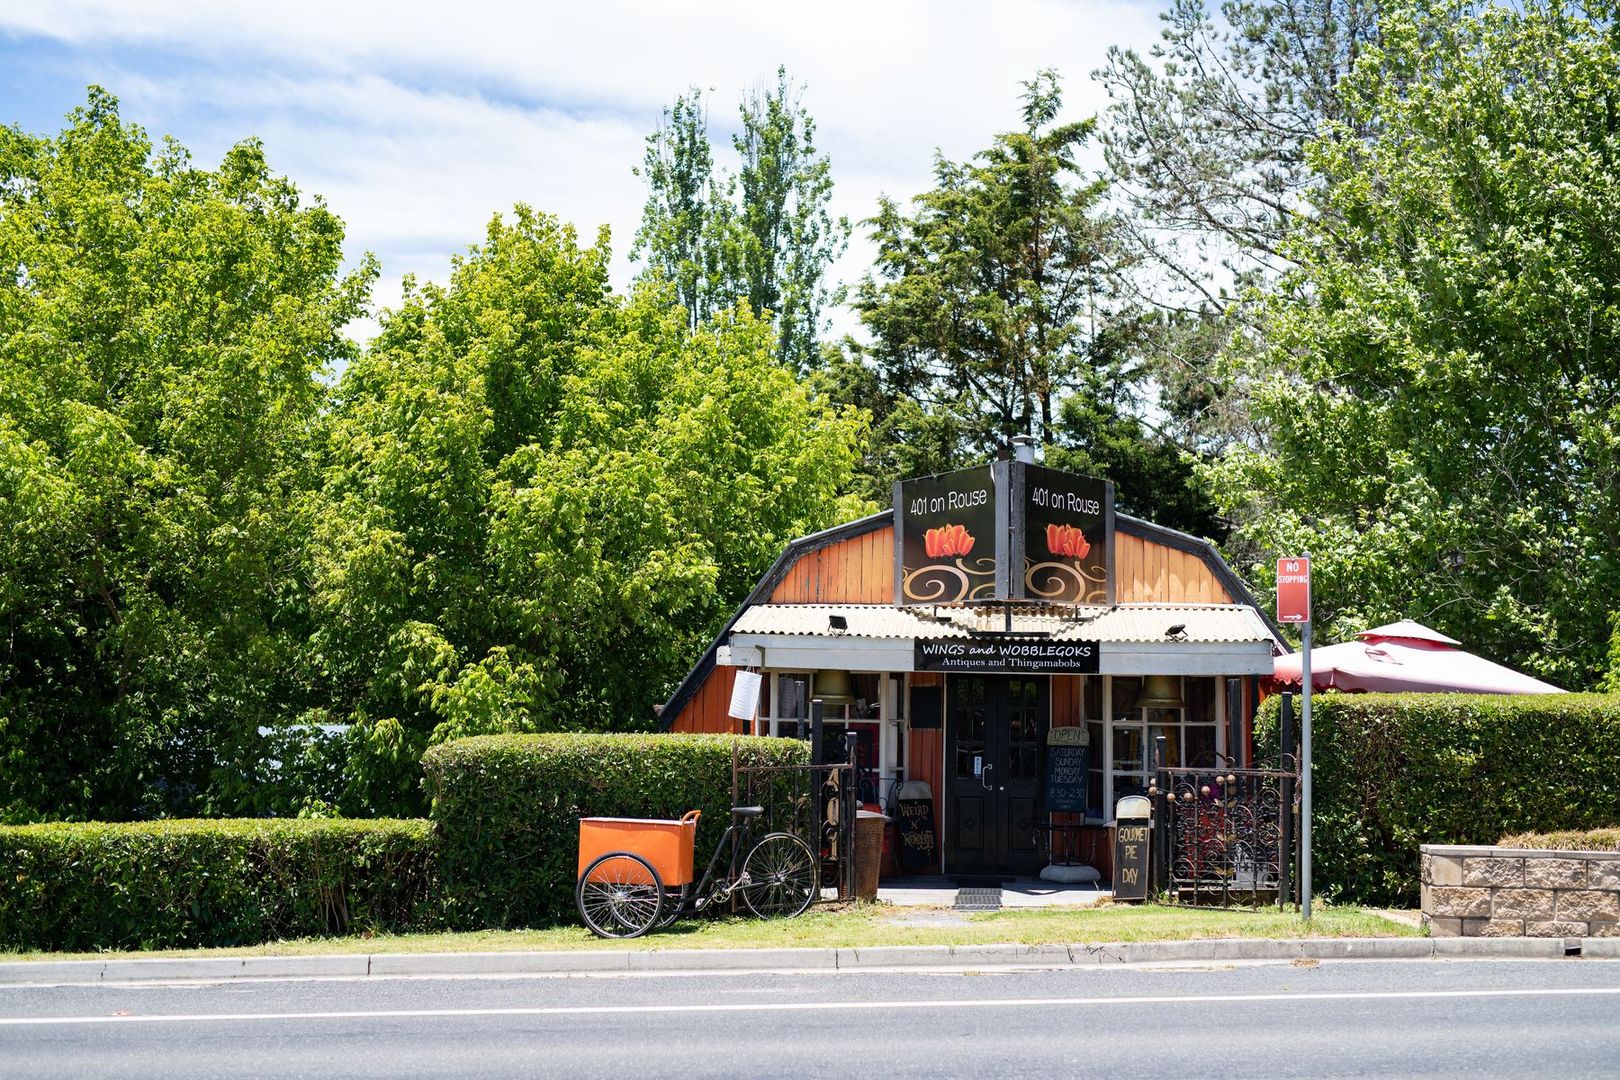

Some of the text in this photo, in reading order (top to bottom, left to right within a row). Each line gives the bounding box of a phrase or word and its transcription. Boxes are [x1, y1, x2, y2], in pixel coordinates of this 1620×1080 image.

[910, 489, 987, 516] 401 on Rouse
[1032, 486, 1100, 515] 401 on Rouse
[1286, 562, 1299, 573] NO
[1278, 575, 1308, 584] STOPPING
[922, 644, 1092, 657] WINGS and WOBBLEGOKS
[942, 657, 1081, 669] Antiques and Thingamabobs
[1053, 729, 1080, 741] OPEN
[1050, 748, 1085, 758] SATURDAY
[1055, 757, 1082, 767] SUNDAY
[1054, 766, 1081, 776] MONDAY
[1051, 774, 1083, 784] TUESDAY
[899, 804, 929, 820] WEIRD
[1118, 827, 1148, 843] GOURMET
[1125, 845, 1138, 859] PIE
[1122, 868, 1139, 886] DAY
